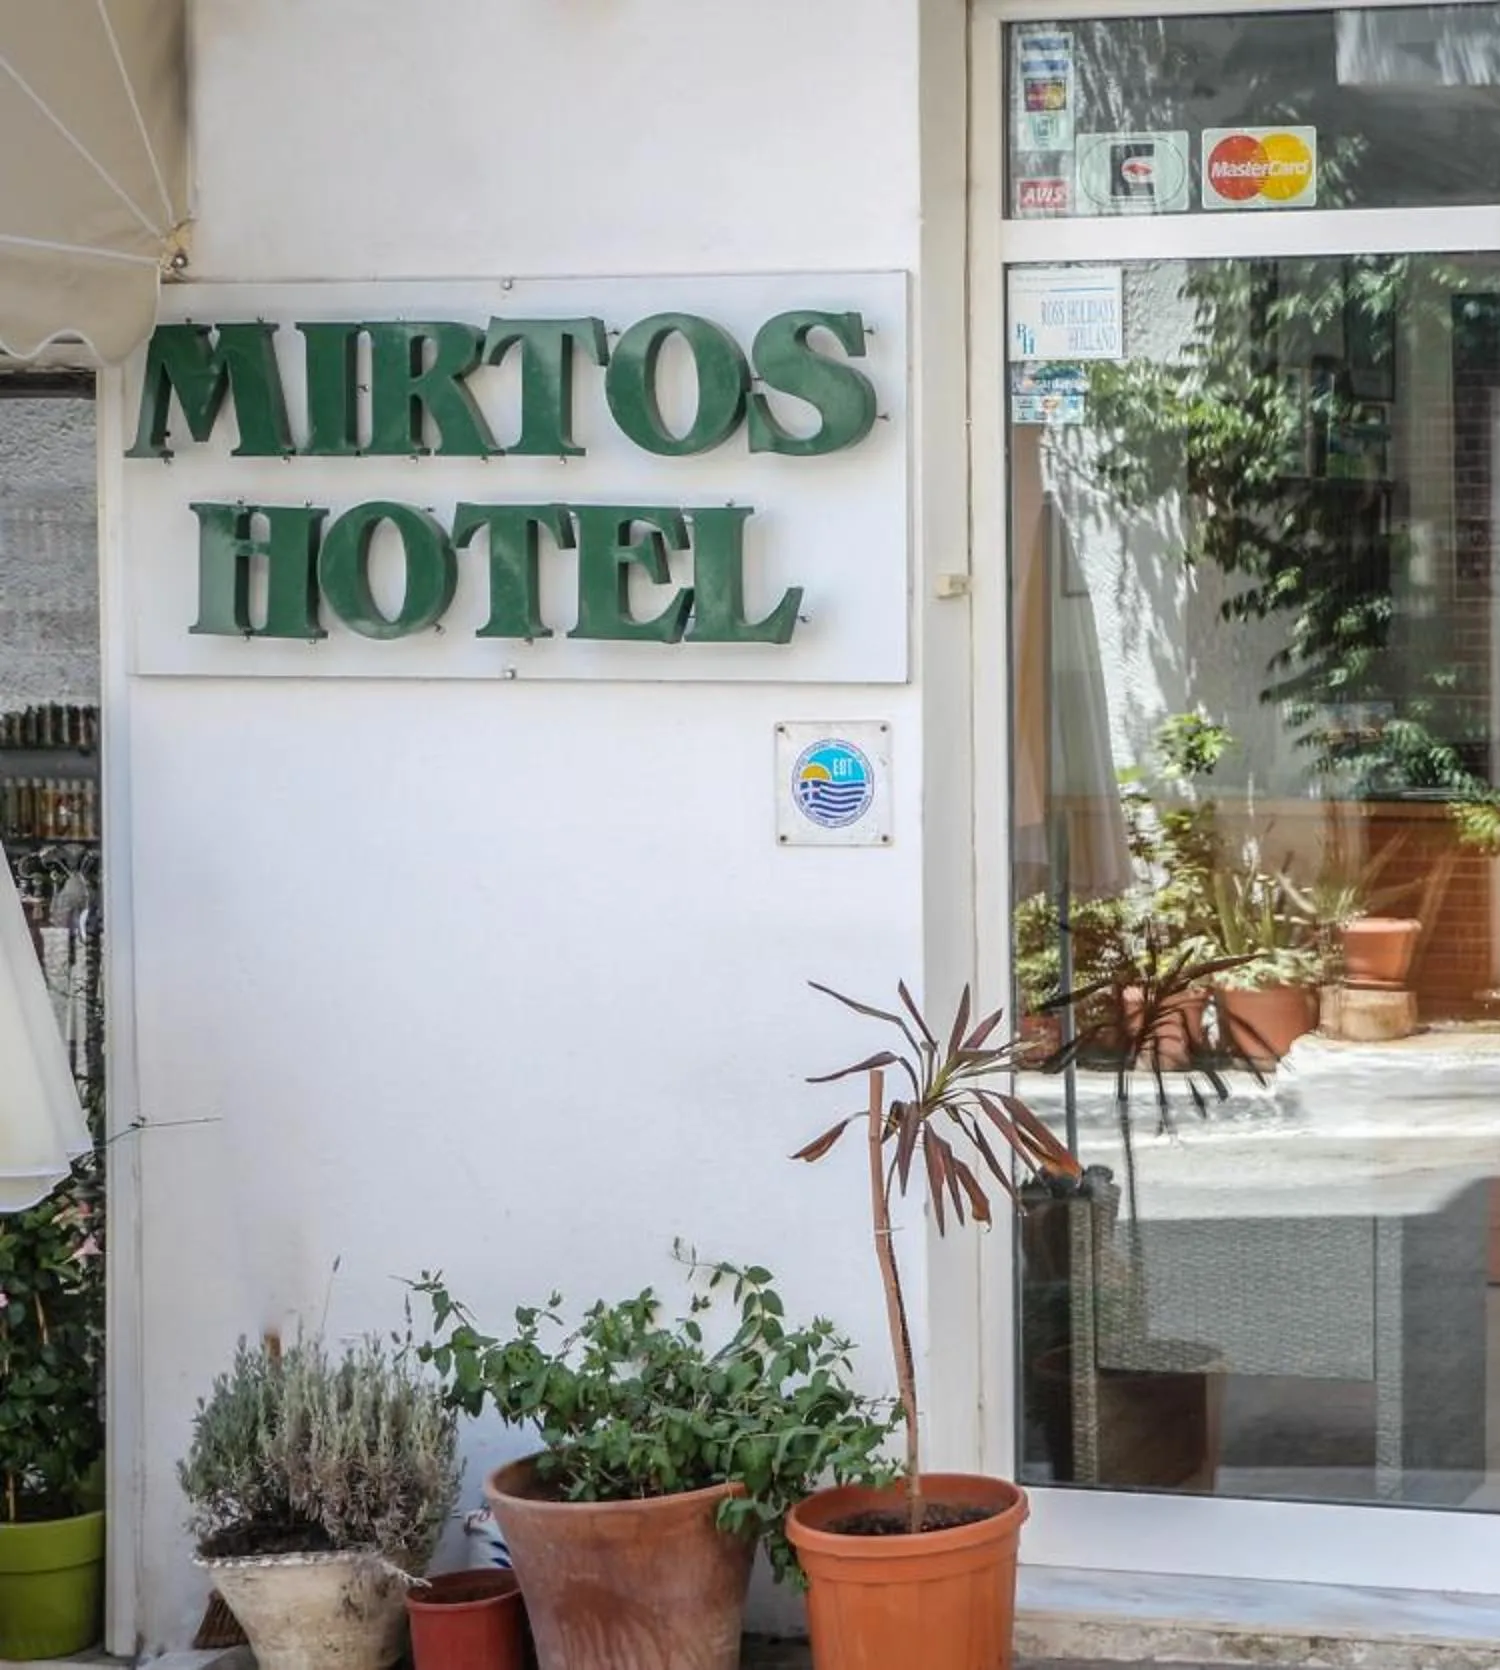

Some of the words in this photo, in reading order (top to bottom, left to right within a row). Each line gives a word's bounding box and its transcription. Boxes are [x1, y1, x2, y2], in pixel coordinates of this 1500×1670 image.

[1023, 186, 1067, 203] AVIS
[1211, 159, 1309, 179] MasterCard
[124, 310, 878, 458] MIRTOS
[188, 500, 804, 645] HOTEL
